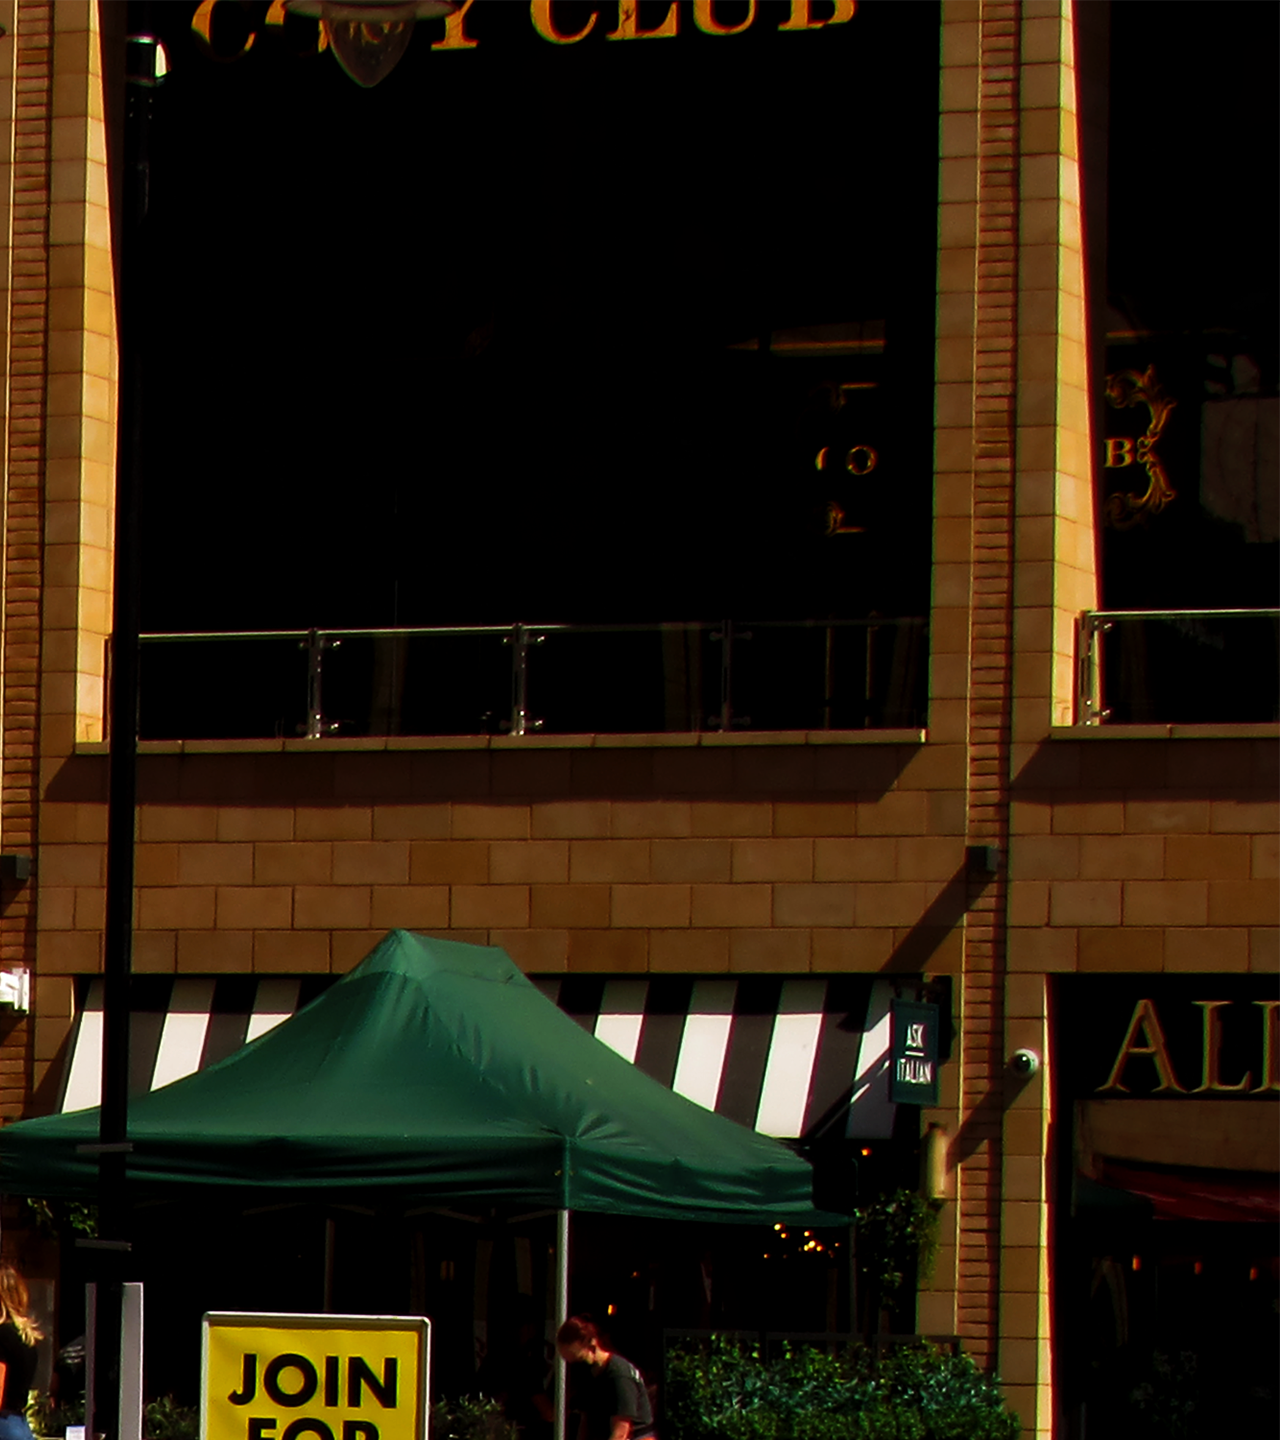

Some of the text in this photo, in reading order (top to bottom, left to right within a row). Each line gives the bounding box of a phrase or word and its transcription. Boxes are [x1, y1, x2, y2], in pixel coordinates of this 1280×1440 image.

[904, 1023, 926, 1049] ASK
[896, 1058, 933, 1085] ITALIAN
[227, 1353, 398, 1409] JOIN
